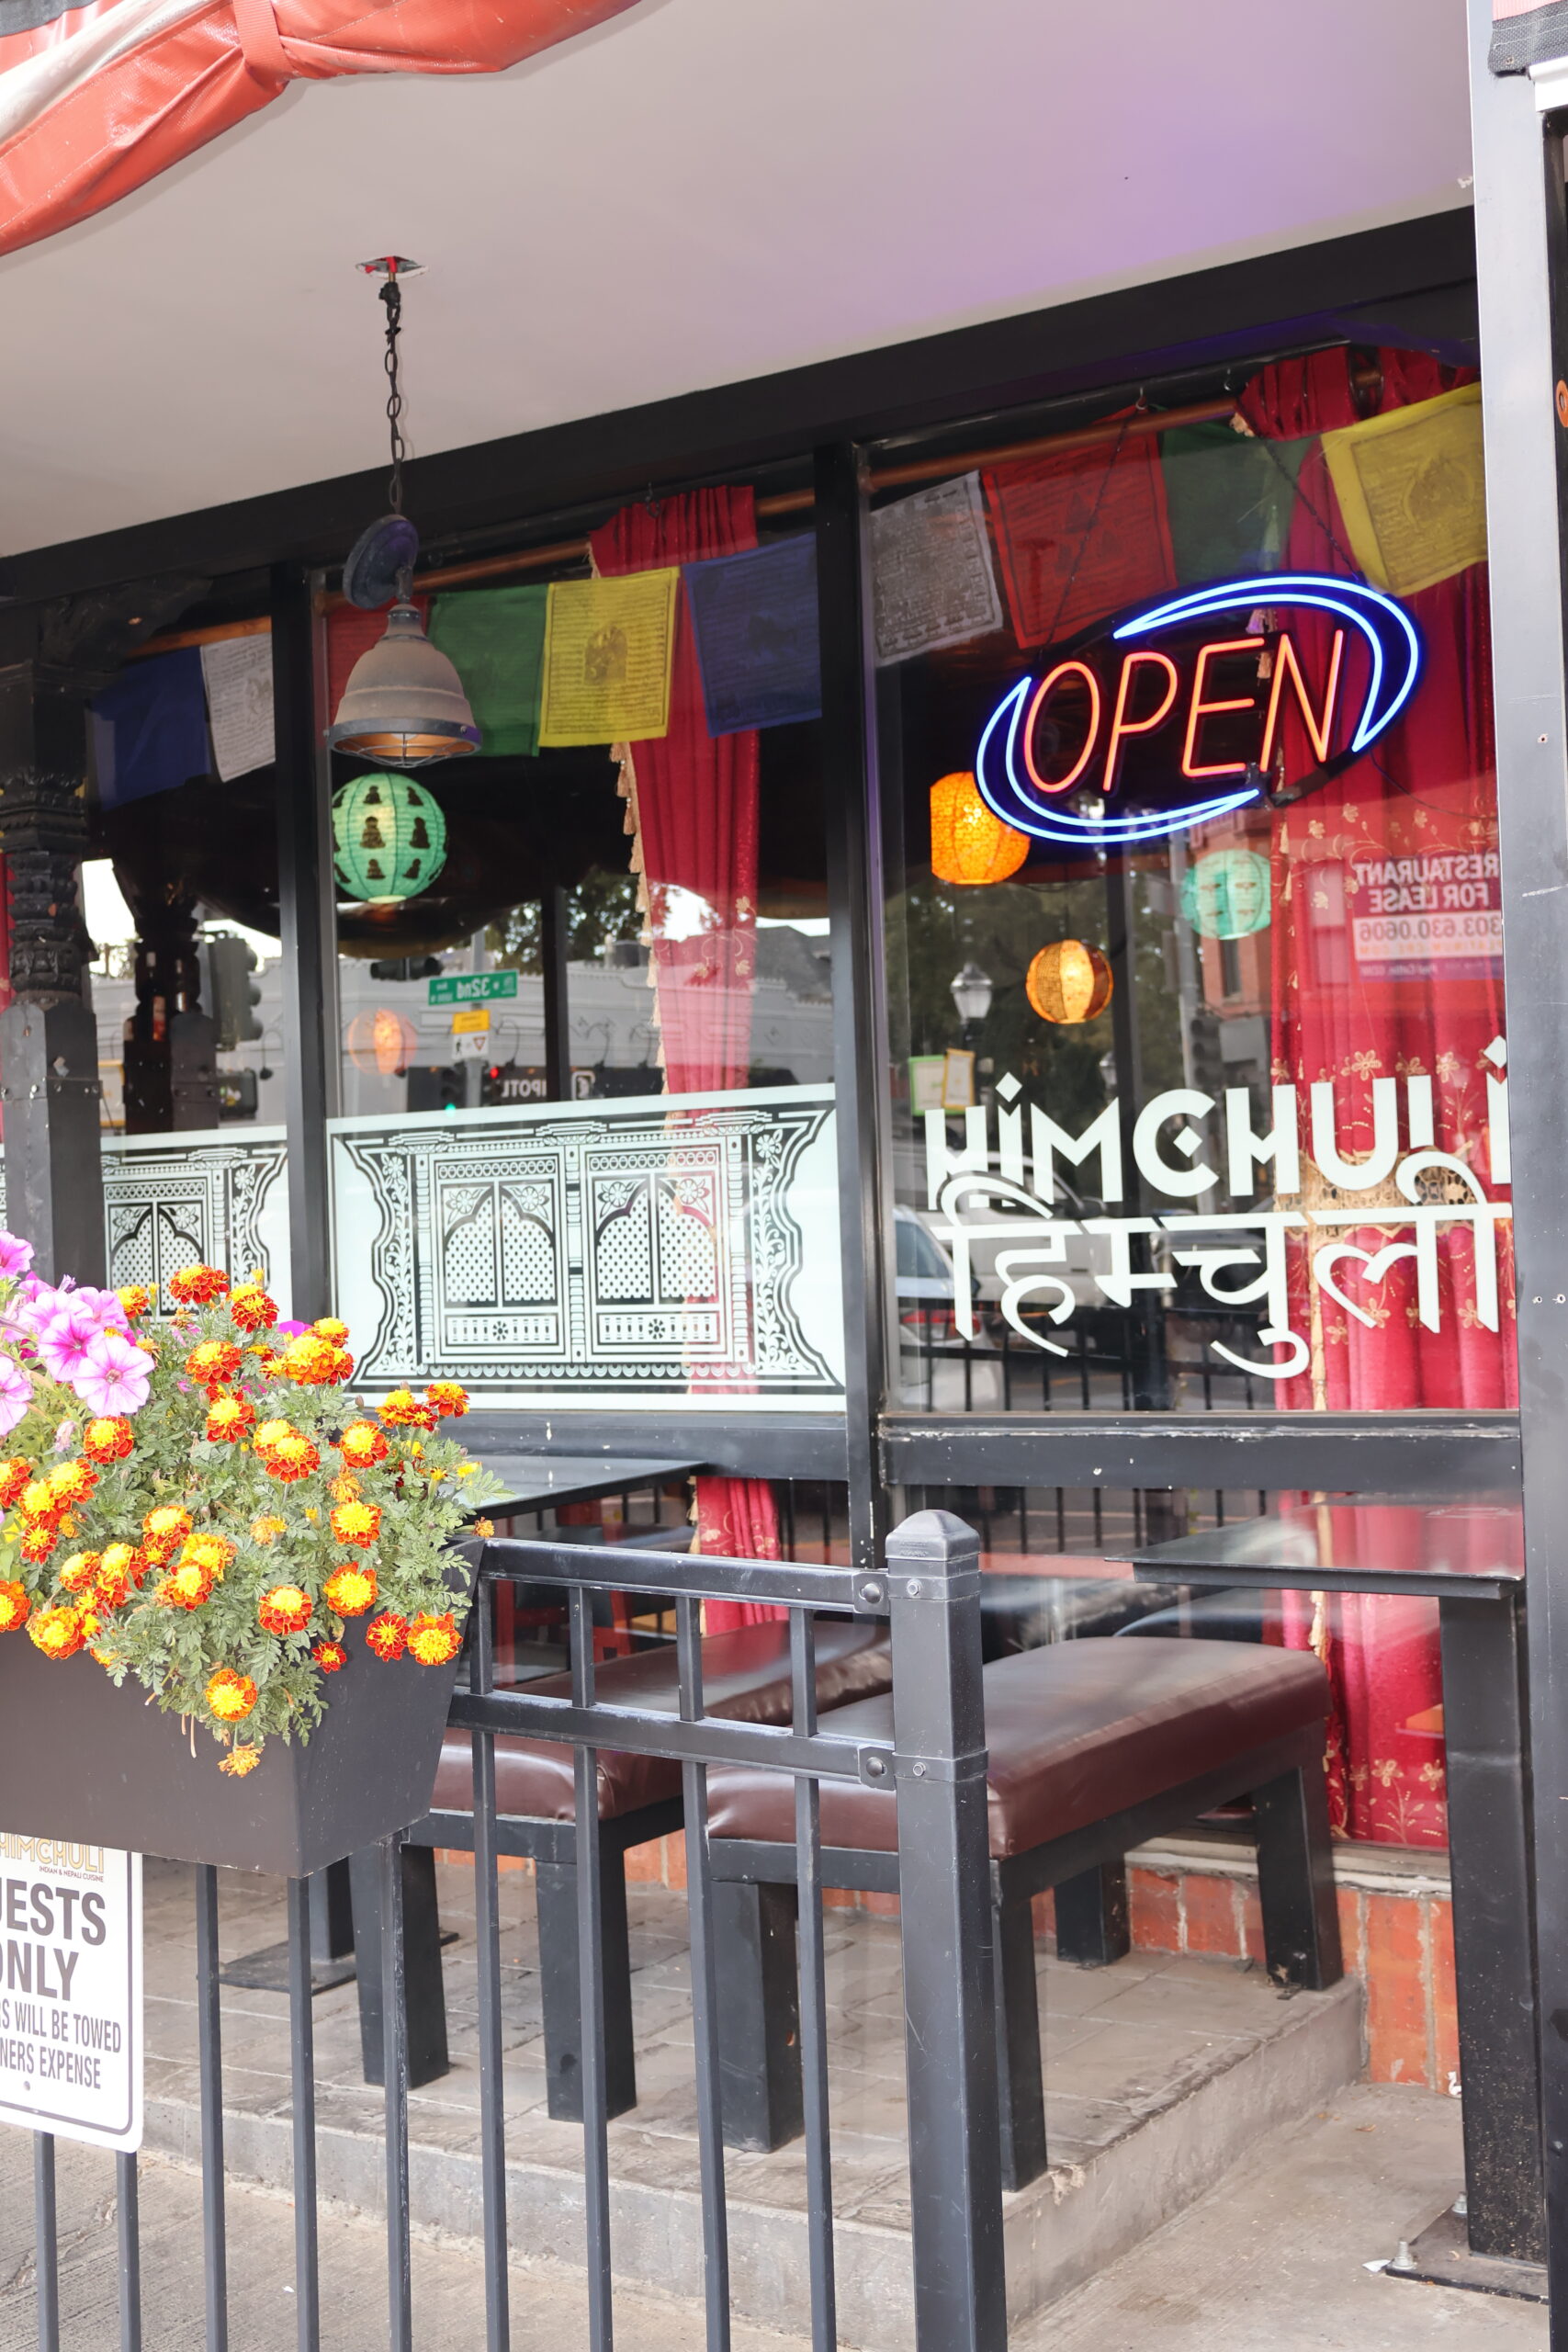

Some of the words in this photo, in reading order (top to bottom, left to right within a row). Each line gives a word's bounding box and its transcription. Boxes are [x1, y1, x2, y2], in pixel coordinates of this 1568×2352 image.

[1024, 629, 1344, 793] OPEN
[39, 1866, 58, 1874] INDIAN
[63, 1870, 82, 1879] NEPALI
[83, 1872, 104, 1883] CUISINE
[0, 1877, 106, 1946] ESTS
[0, 1939, 79, 2001] NLY
[15, 2000, 47, 2038] WILL
[51, 2008, 69, 2042] BE
[73, 2013, 121, 2053] TOWED
[39, 2045, 101, 2089] EXPENSE
